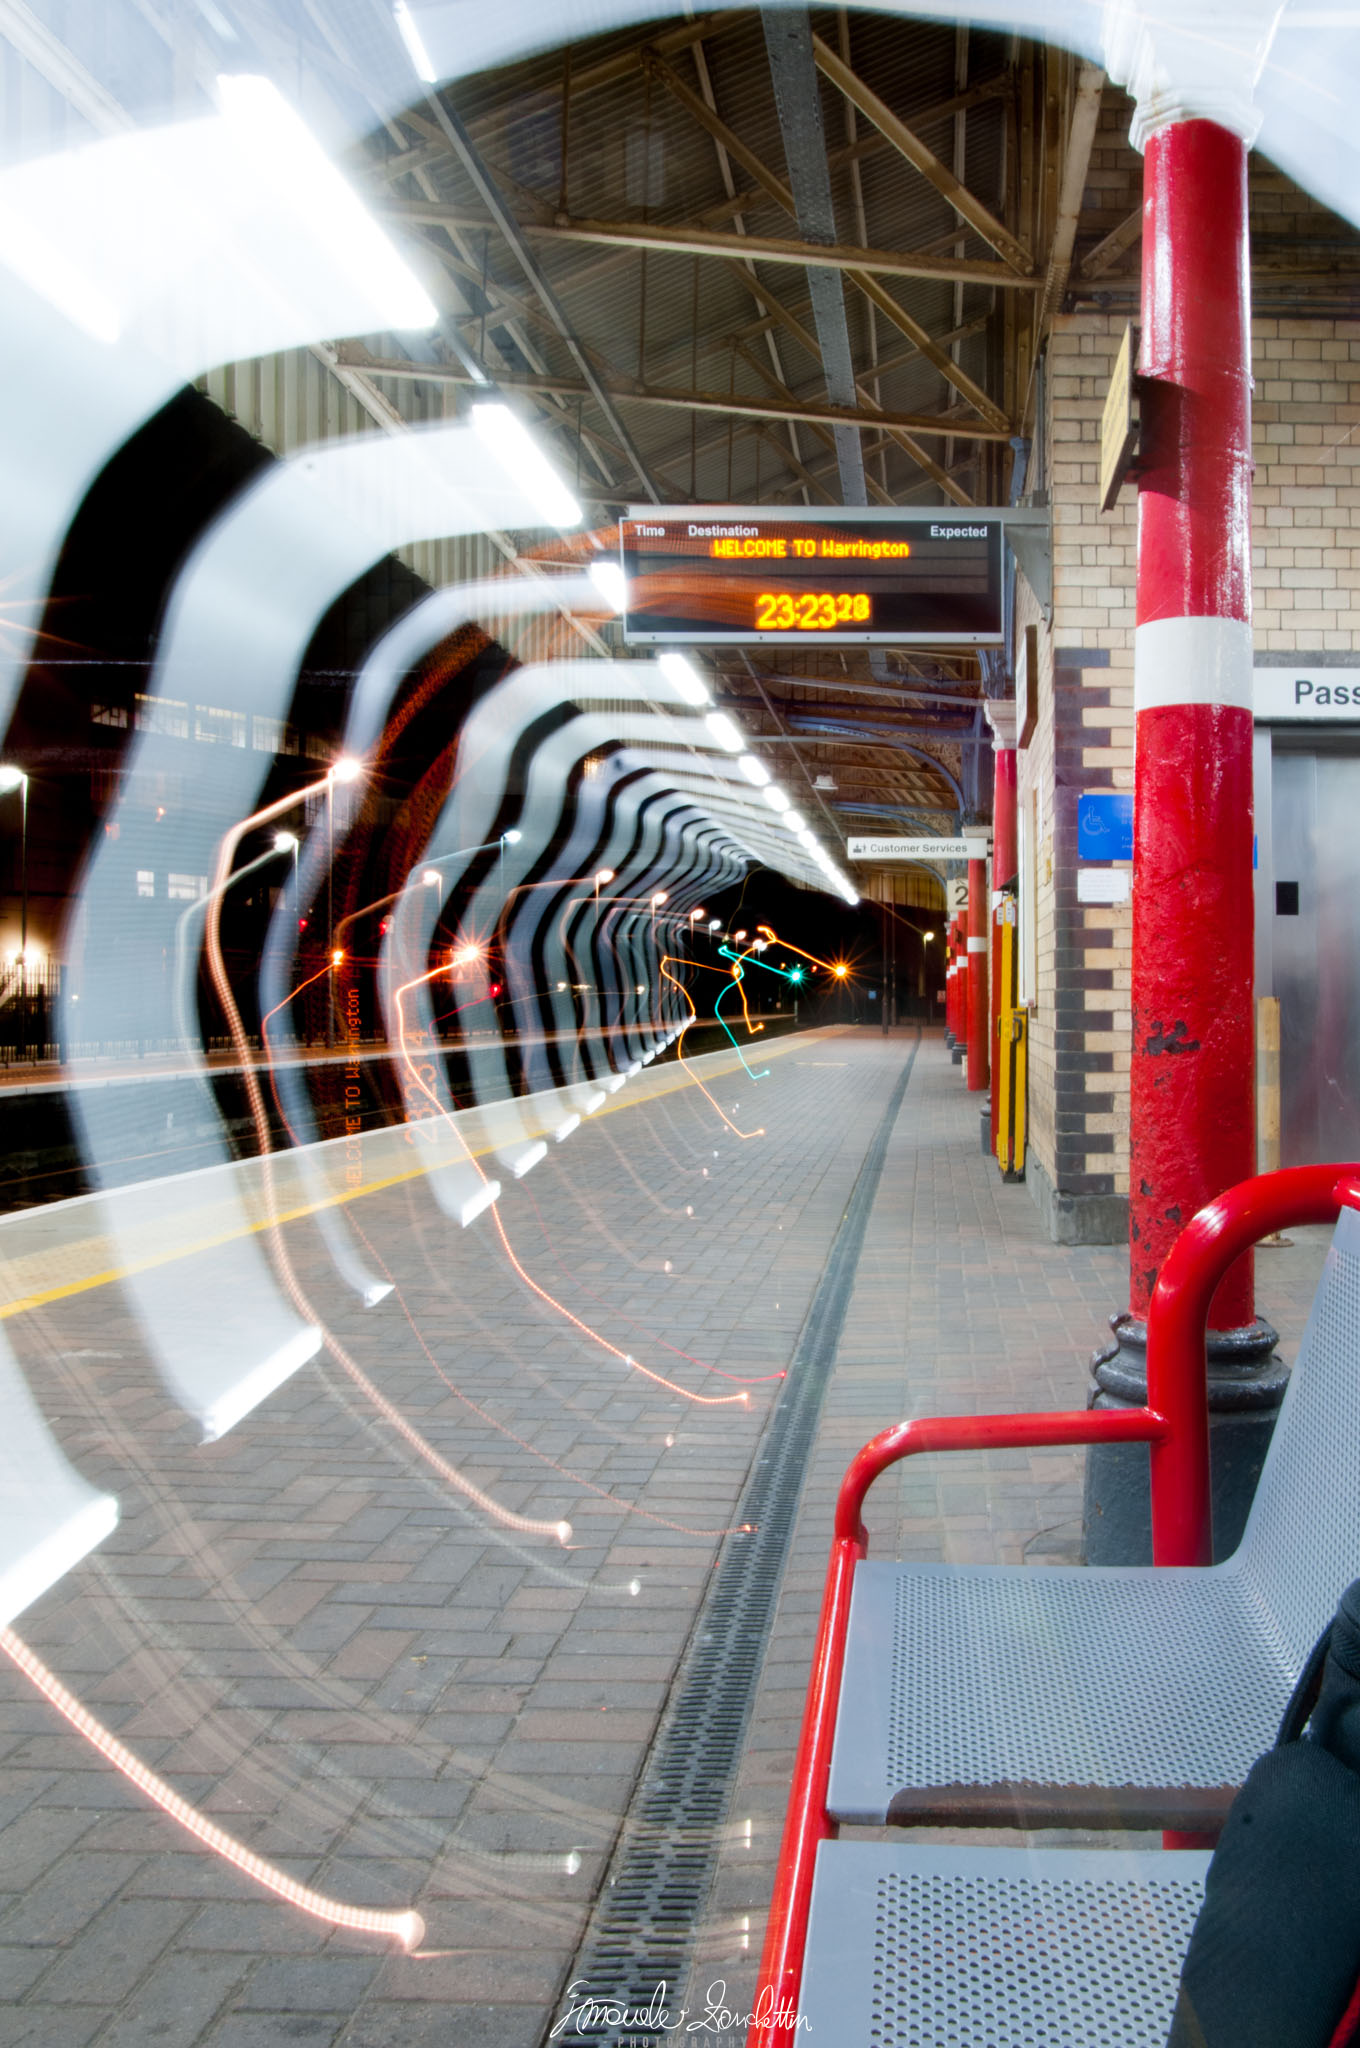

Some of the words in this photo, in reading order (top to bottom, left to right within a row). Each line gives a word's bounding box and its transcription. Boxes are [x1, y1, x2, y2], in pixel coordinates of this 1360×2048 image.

[635, 525, 665, 536] Time
[688, 525, 759, 537] Destination
[930, 525, 988, 540] Expected
[713, 540, 787, 557] WELCOME
[793, 540, 817, 556] TO
[821, 540, 910, 560] Warrington
[1295, 680, 1360, 705] Pass
[870, 843, 920, 854] Customer
[922, 843, 968, 854] Services
[955, 885, 968, 906] 2
[345, 1086, 361, 1109] TO
